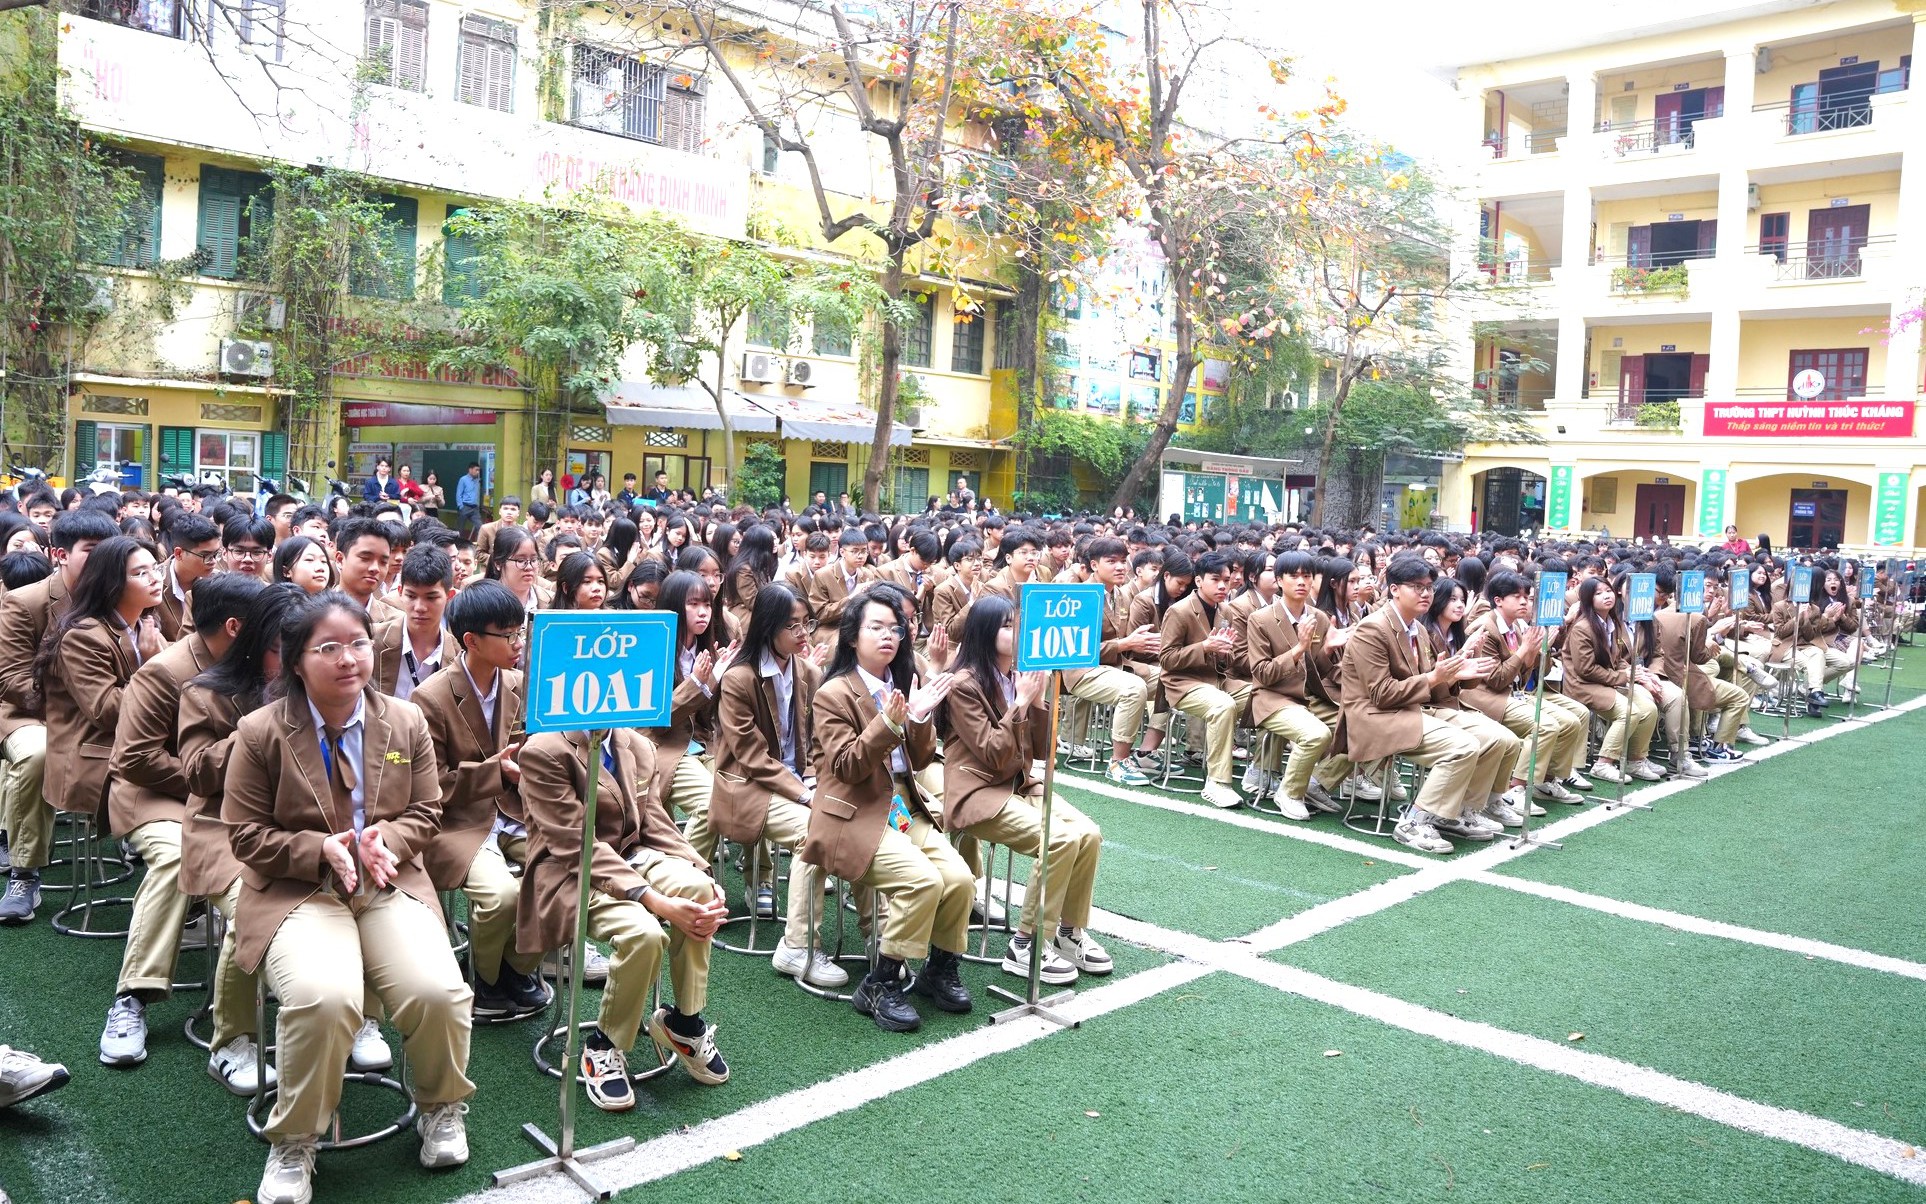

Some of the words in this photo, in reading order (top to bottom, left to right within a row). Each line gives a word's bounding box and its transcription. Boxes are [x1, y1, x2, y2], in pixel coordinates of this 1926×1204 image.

[1713, 405, 1755, 418] TRƯỜNG
[1758, 407, 1785, 418] THPT
[1787, 405, 1826, 418] HUỲNH
[1828, 404, 1859, 418] THÚC
[1861, 404, 1904, 418] KHÁNG
[1753, 421, 1778, 431] sáng
[1808, 422, 1822, 430] tin
[1825, 421, 1838, 430] và
[1546, 579, 1560, 593] LỚP
[1044, 593, 1082, 618] LỚP
[1540, 598, 1562, 619] 10D1
[573, 626, 637, 659] LỚP
[1028, 624, 1091, 659] 10N1
[544, 668, 656, 716] 10A1
